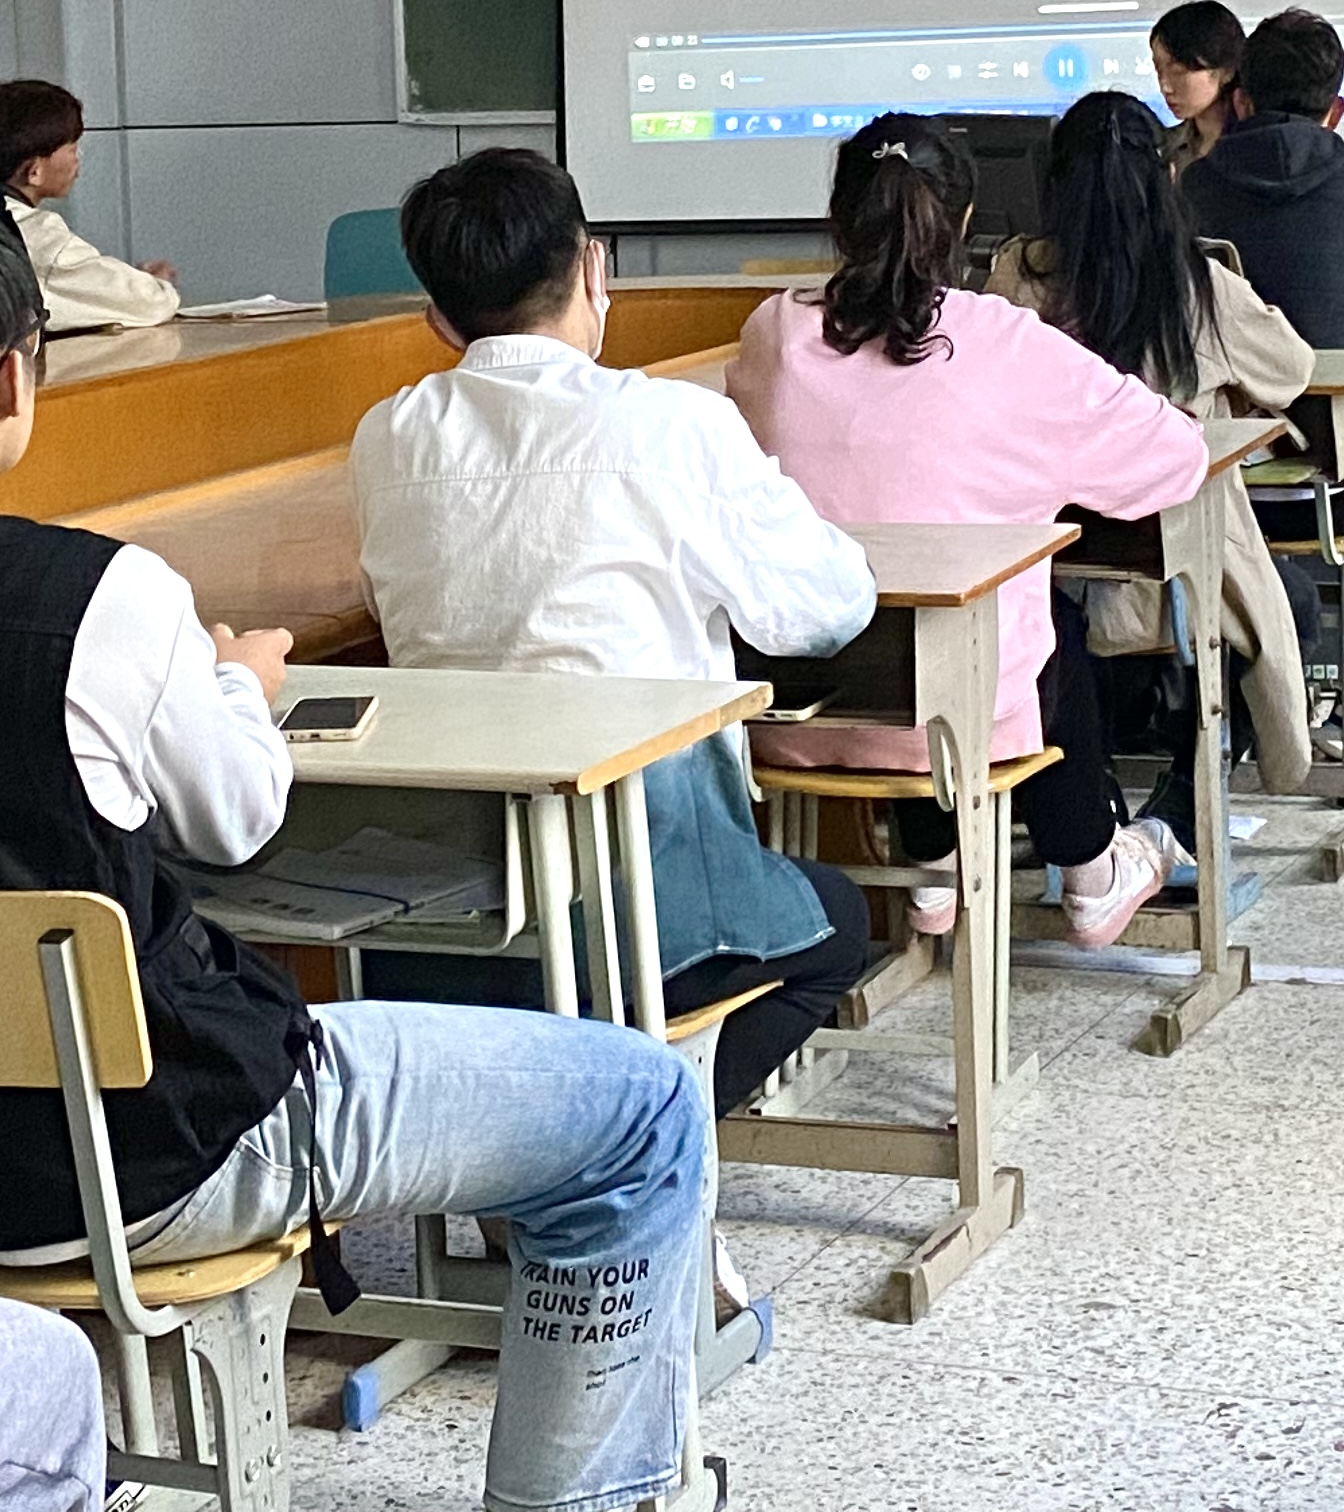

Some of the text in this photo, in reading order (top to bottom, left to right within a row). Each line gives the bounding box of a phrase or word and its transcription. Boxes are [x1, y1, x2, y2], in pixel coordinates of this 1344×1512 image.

[587, 1258, 649, 1288] YOUR
[526, 1290, 635, 1316] GUNS ON
[523, 1308, 653, 1344] THE TARGET
